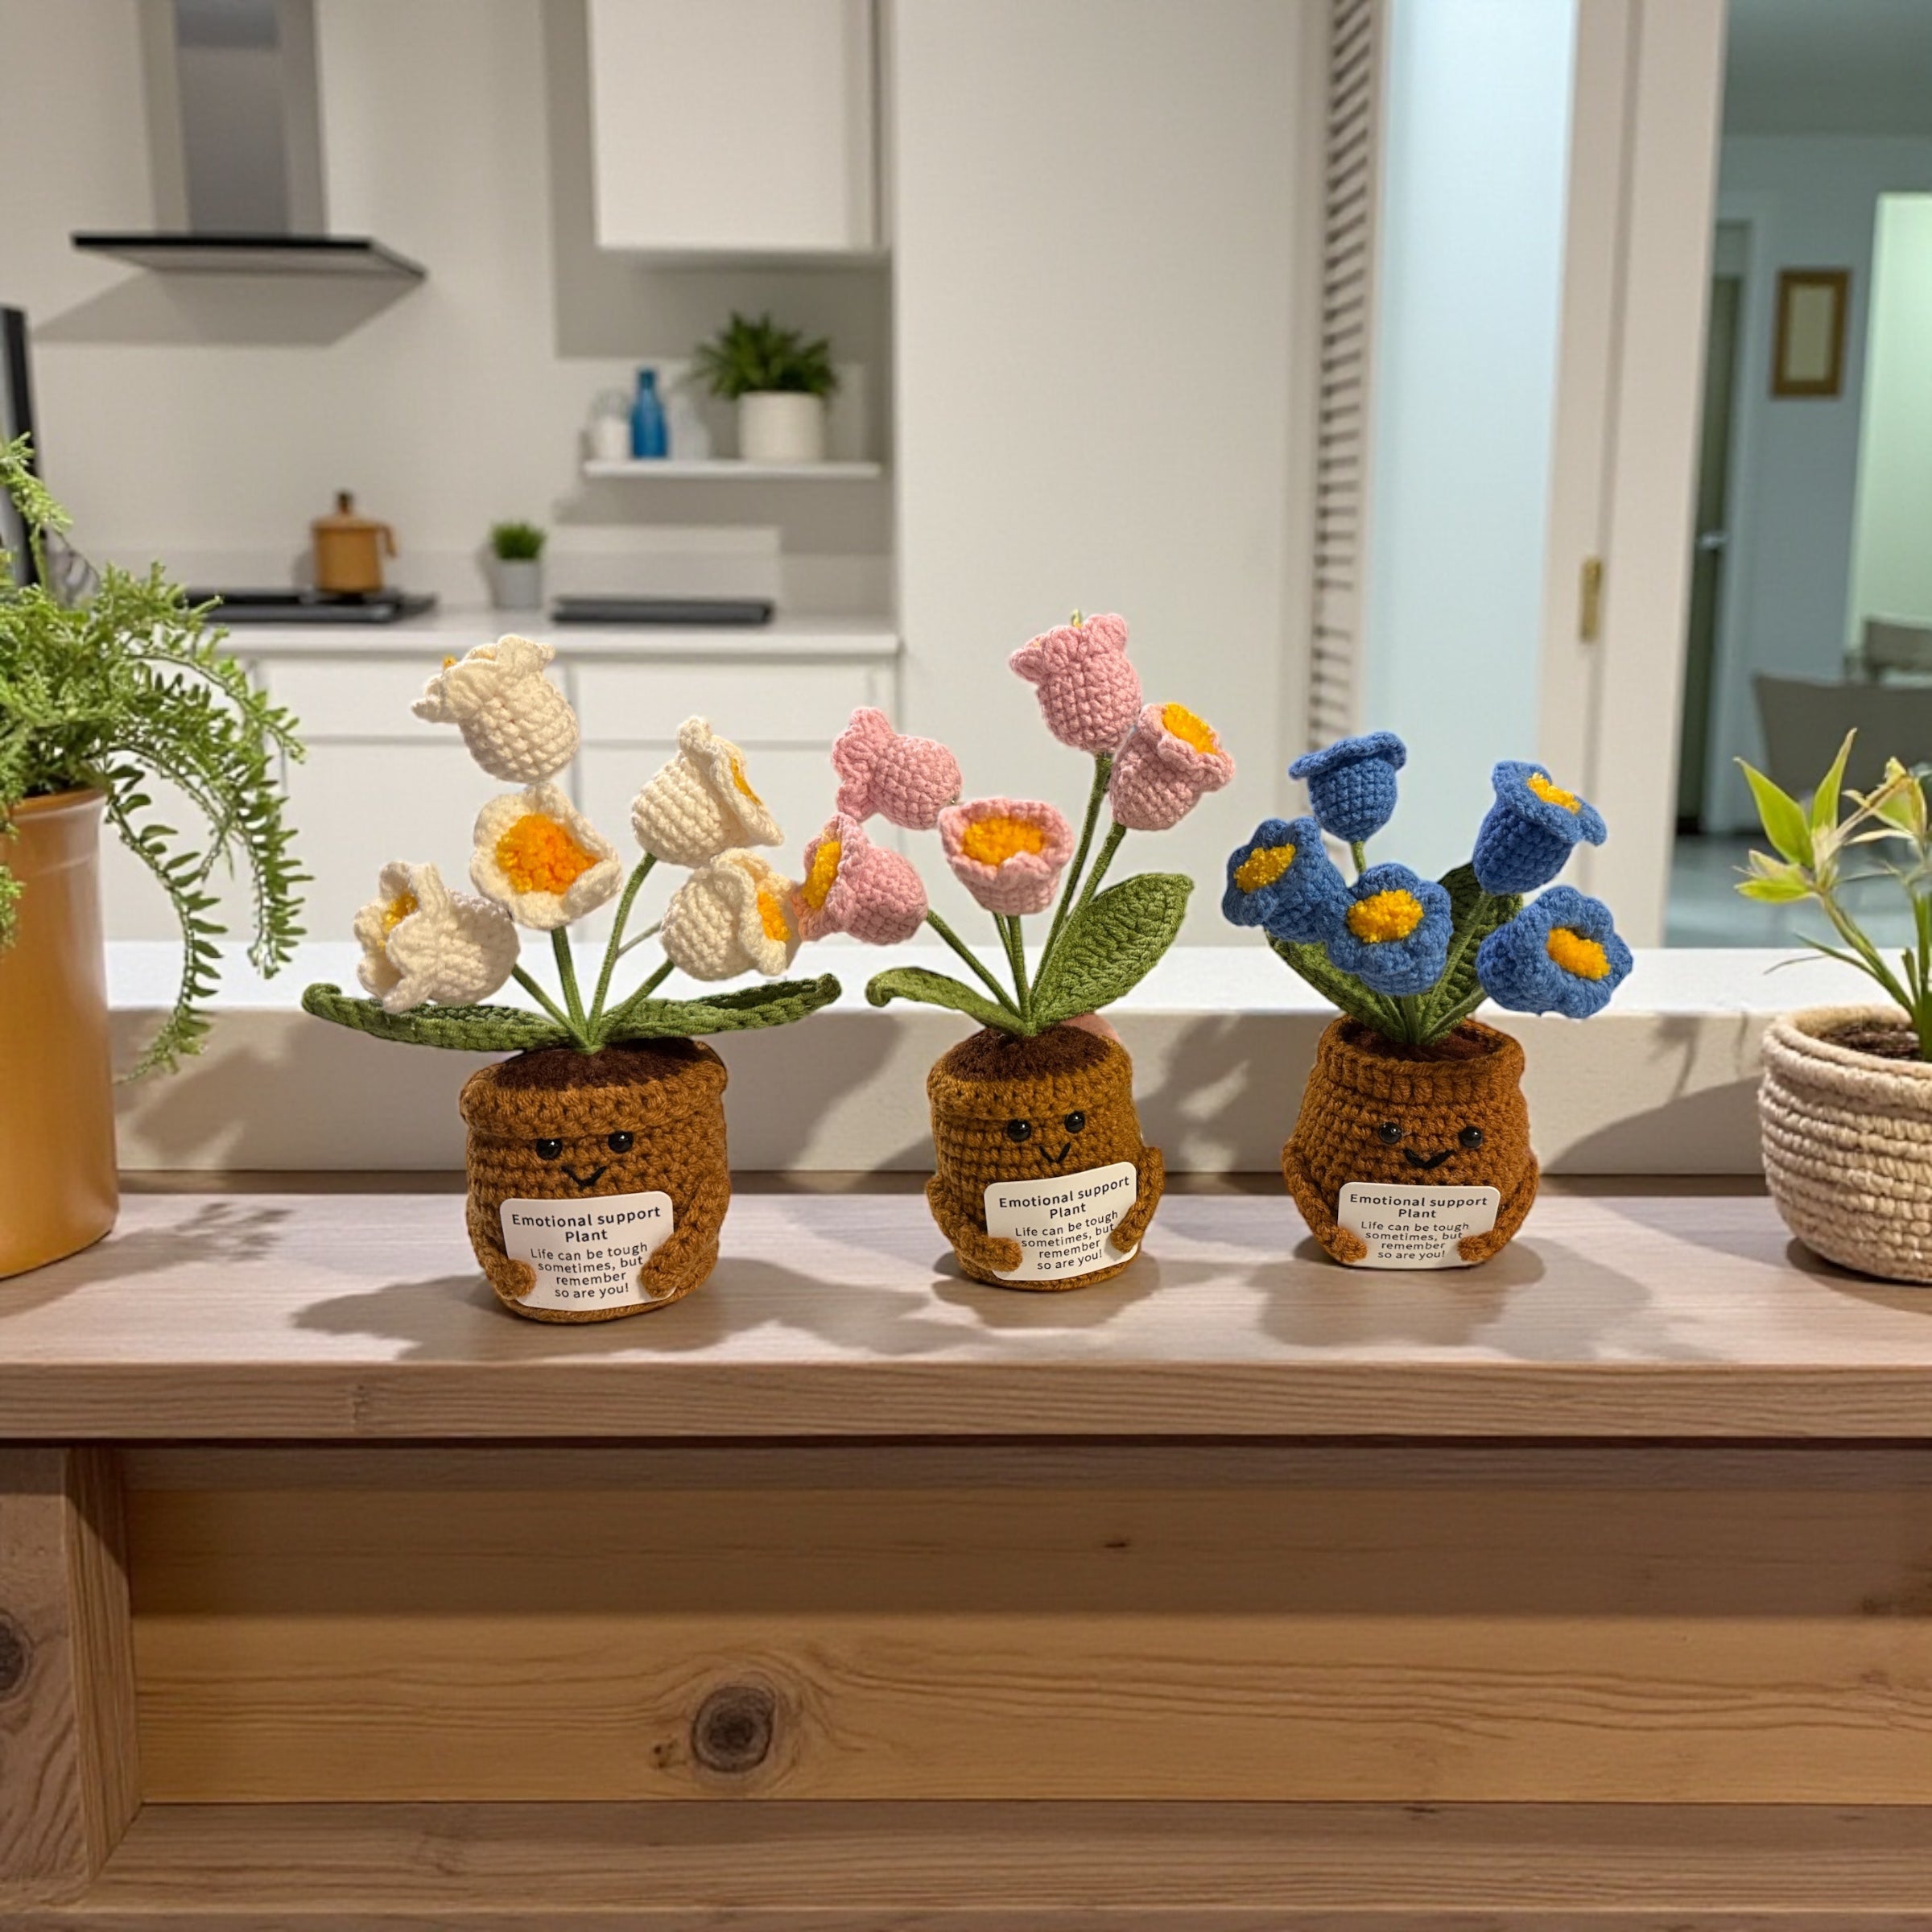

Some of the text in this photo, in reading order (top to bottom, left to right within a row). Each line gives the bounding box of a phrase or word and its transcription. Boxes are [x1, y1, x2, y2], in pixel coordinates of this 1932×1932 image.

[999, 1176, 1129, 1208] Emotional support
[1350, 1194, 1488, 1208] Emotional support
[512, 1207, 661, 1227] Emotional support
[1050, 1203, 1086, 1219] Plant
[1398, 1209, 1437, 1218] Plant
[1016, 1211, 1117, 1236] Life can be tough
[1361, 1221, 1384, 1230] Life
[1388, 1223, 1409, 1231] can
[1434, 1223, 1469, 1232] tough
[565, 1229, 609, 1243] Plant
[1022, 1224, 1114, 1247] sometimes, but
[1365, 1232, 1463, 1241] sometimes, but
[530, 1243, 647, 1261] Life can be tough
[1039, 1240, 1100, 1258] remember
[1418, 1251, 1445, 1260] you!
[539, 1256, 643, 1273] sometimes, but
[1055, 1259, 1074, 1269] are
[1078, 1249, 1102, 1266] you!
[556, 1272, 626, 1286] remember
[555, 1282, 629, 1298] so are you!
